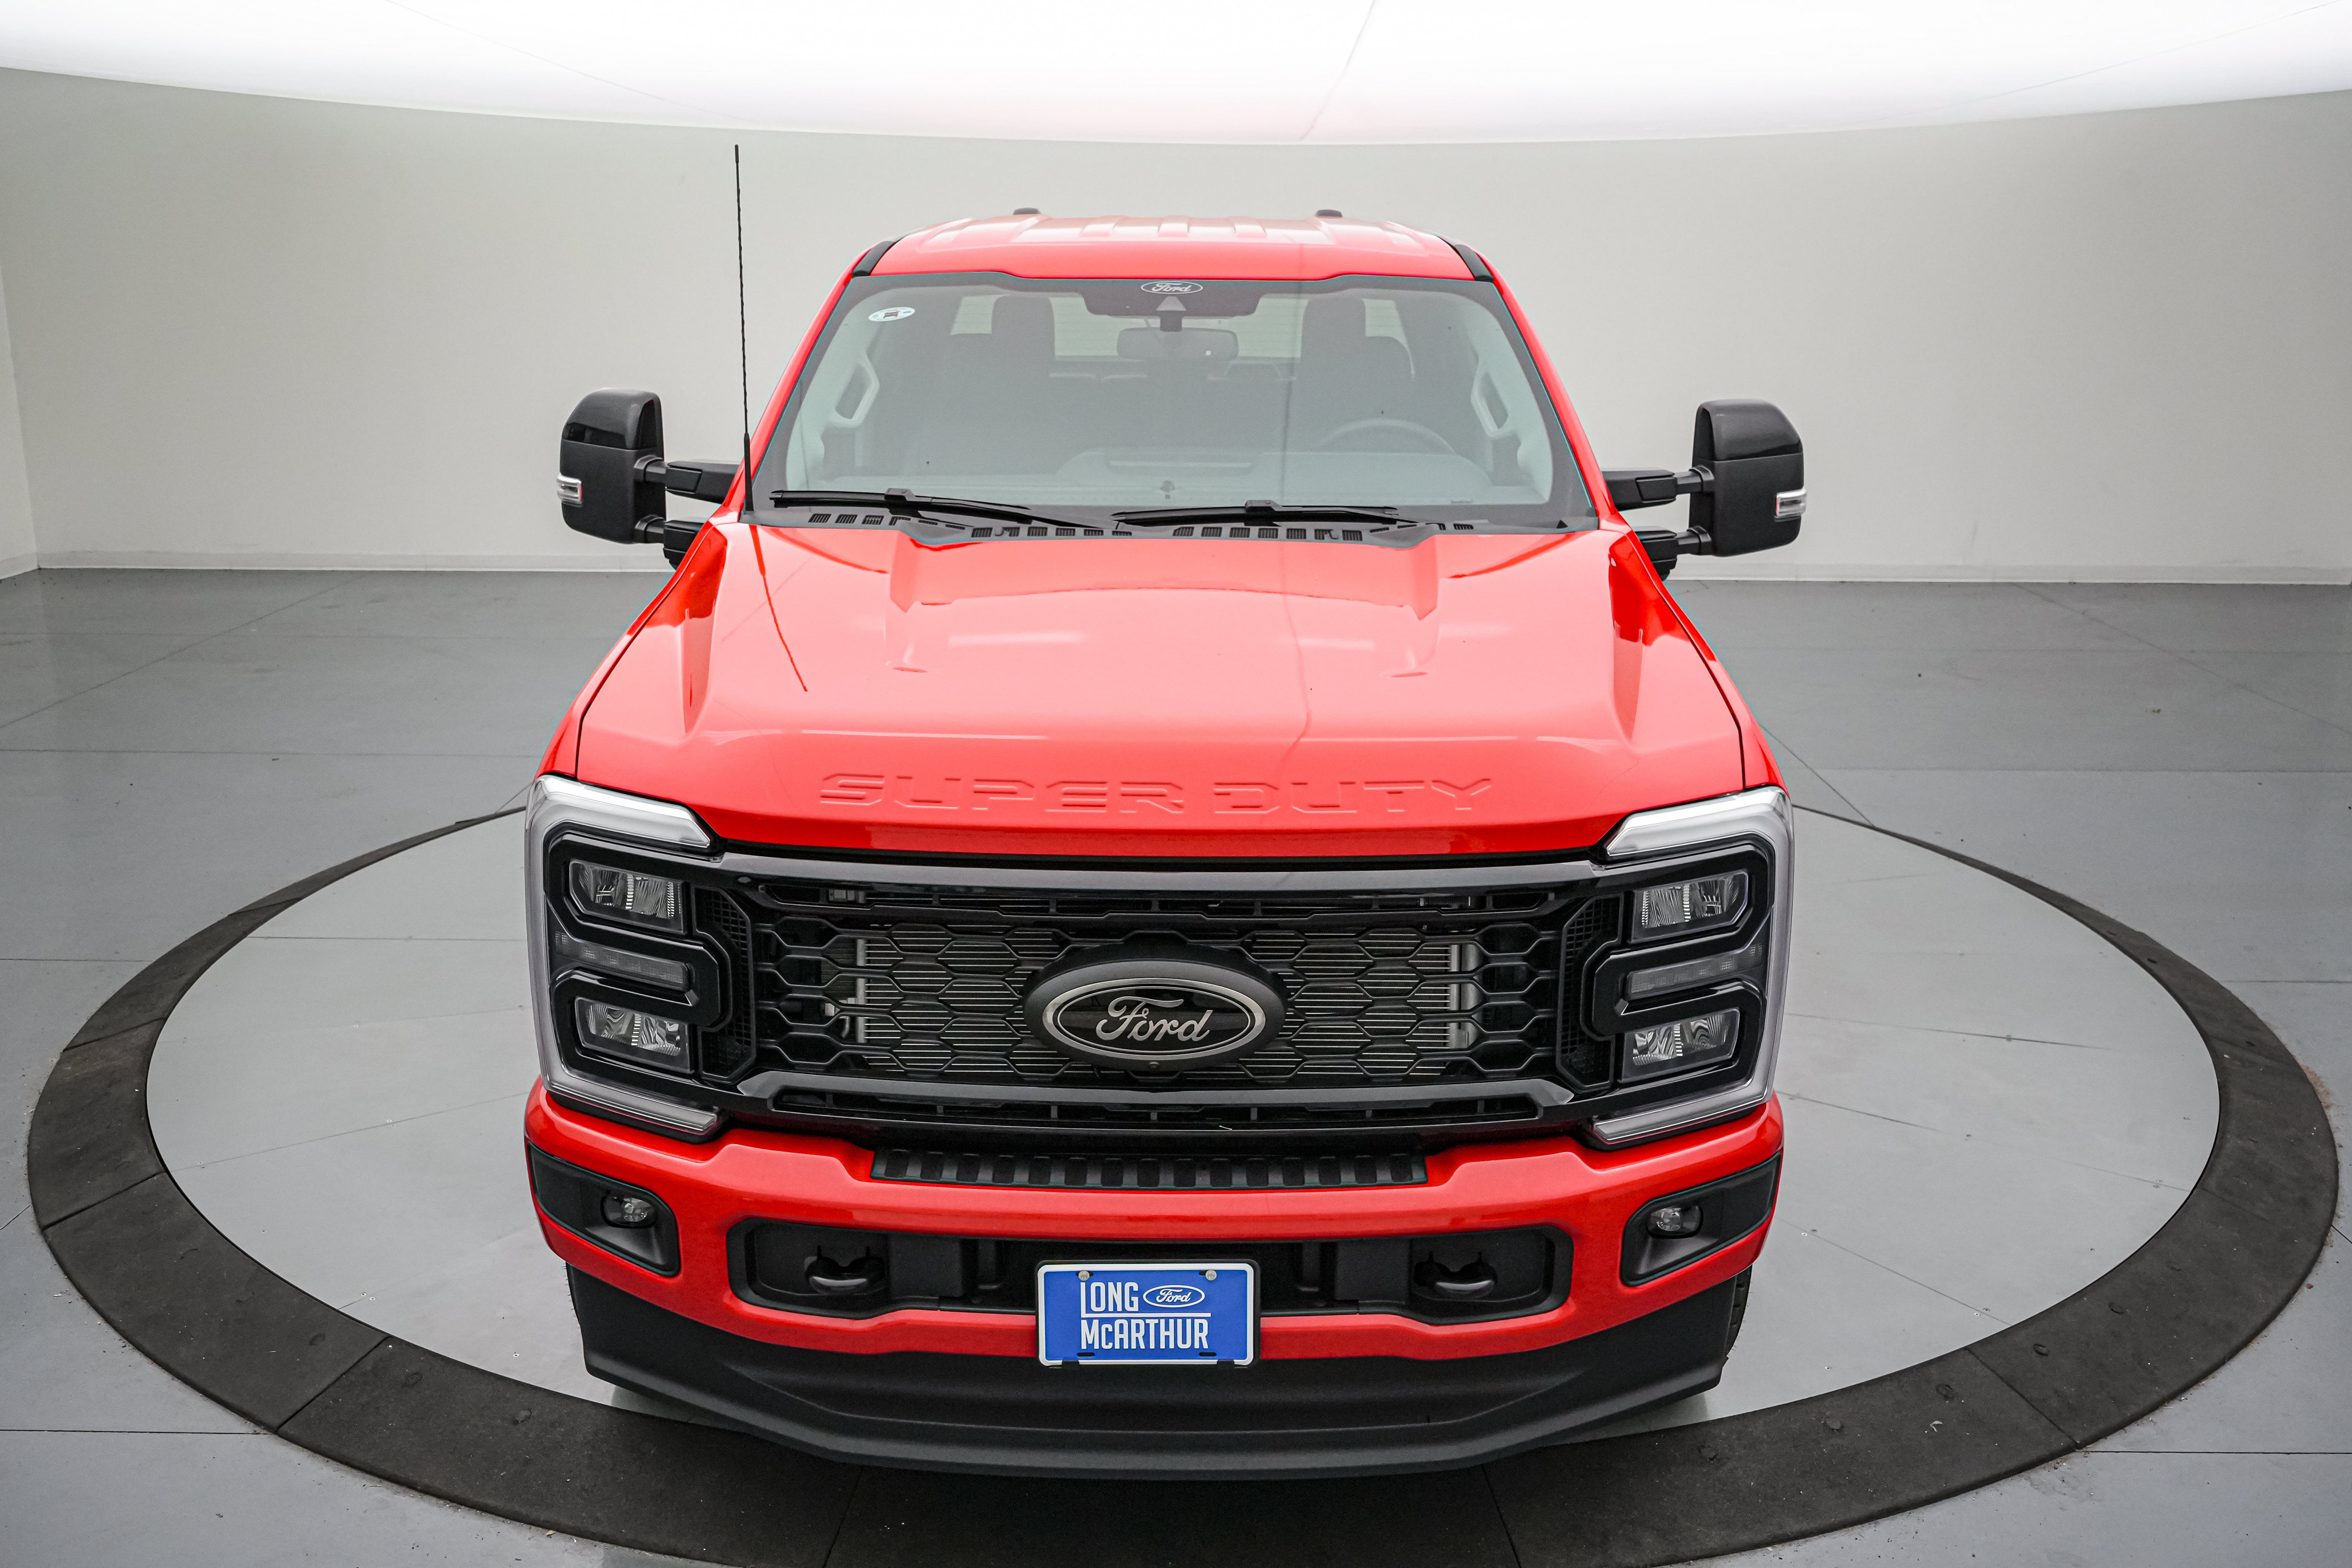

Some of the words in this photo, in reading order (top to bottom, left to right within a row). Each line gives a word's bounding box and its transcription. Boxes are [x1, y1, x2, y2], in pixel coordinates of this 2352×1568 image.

[1152, 283, 1192, 292] Ford
[820, 773, 1185, 813] SUPER
[1214, 777, 1491, 813] DUTY
[1096, 996, 1213, 1042] Ford
[1080, 1281, 1139, 1316] LONG
[1156, 1288, 1191, 1303] Ford
[1080, 1319, 1209, 1350] McARTHUR
